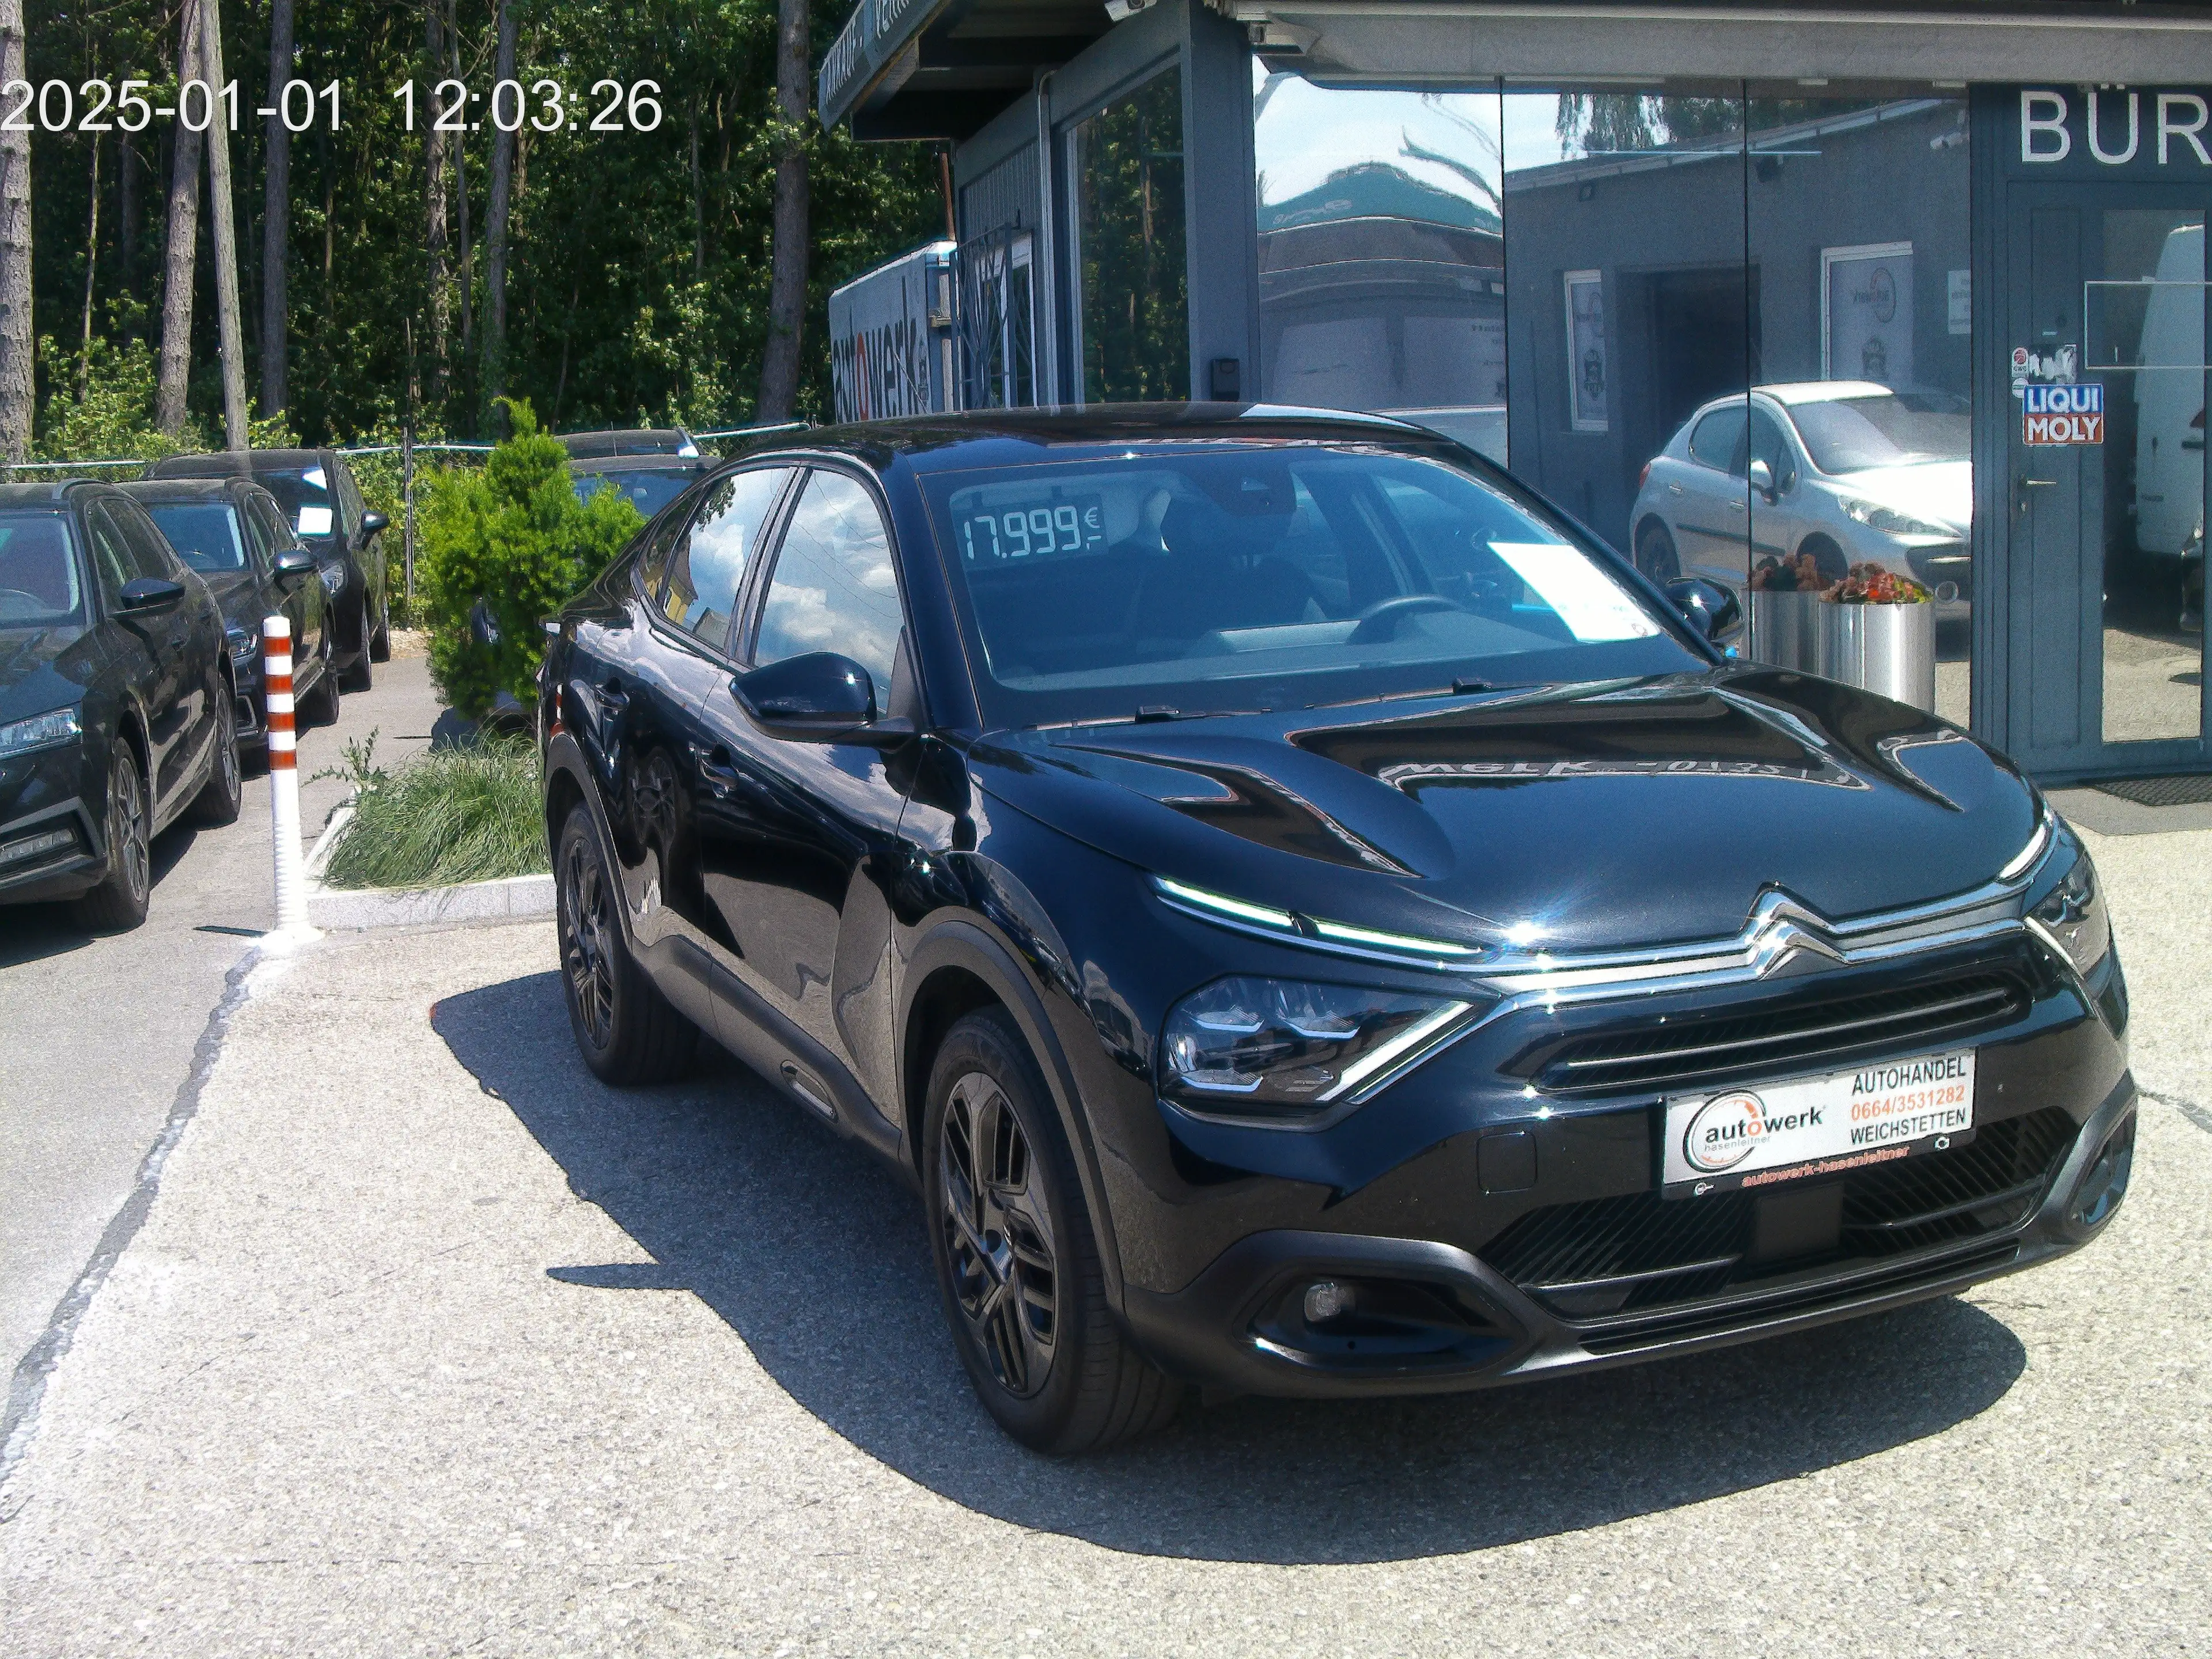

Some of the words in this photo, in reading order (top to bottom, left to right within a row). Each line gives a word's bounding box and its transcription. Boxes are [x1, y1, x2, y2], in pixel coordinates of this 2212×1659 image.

[2021, 84, 2212, 165] BÜR
[2028, 387, 2099, 413] LIQUI
[2028, 416, 2101, 441] MOLY
[963, 505, 1081, 560] 17.999
[1852, 1056, 1966, 1096] AUTOHANDEL
[1851, 1085, 1965, 1122] 0664/3531282
[1705, 1106, 1823, 1143] autowerk
[1851, 1108, 1966, 1145] WEICHSTETTEN
[1705, 1135, 1771, 1152] hasenleitner
[1741, 1145, 1910, 1188] autowerk-hasenleitner
